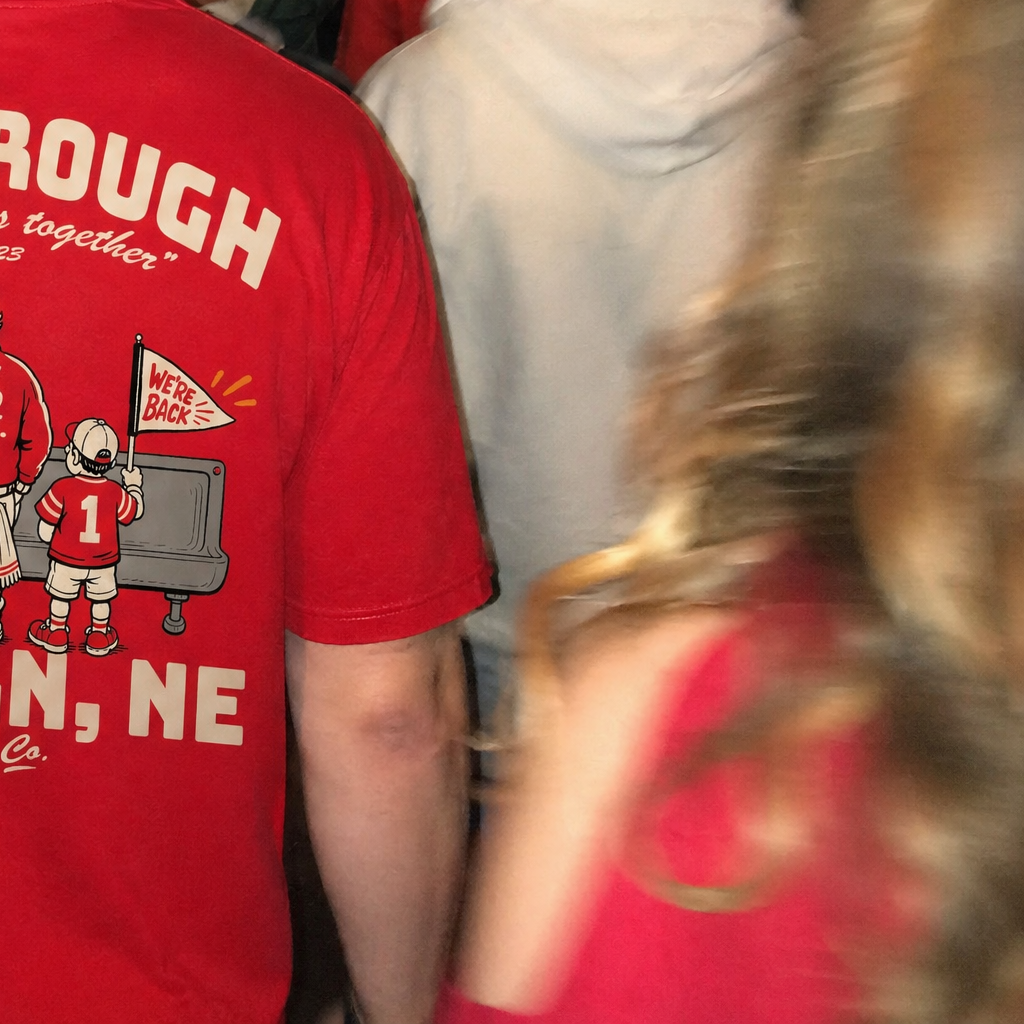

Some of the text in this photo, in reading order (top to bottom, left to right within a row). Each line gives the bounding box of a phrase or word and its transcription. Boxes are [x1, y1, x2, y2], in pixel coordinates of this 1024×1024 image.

[149, 362, 196, 406] WE'RE
[142, 393, 192, 425] BACK
[79, 494, 101, 544] 1
[128, 658, 246, 746] NE
[0, 733, 49, 764] Co.
